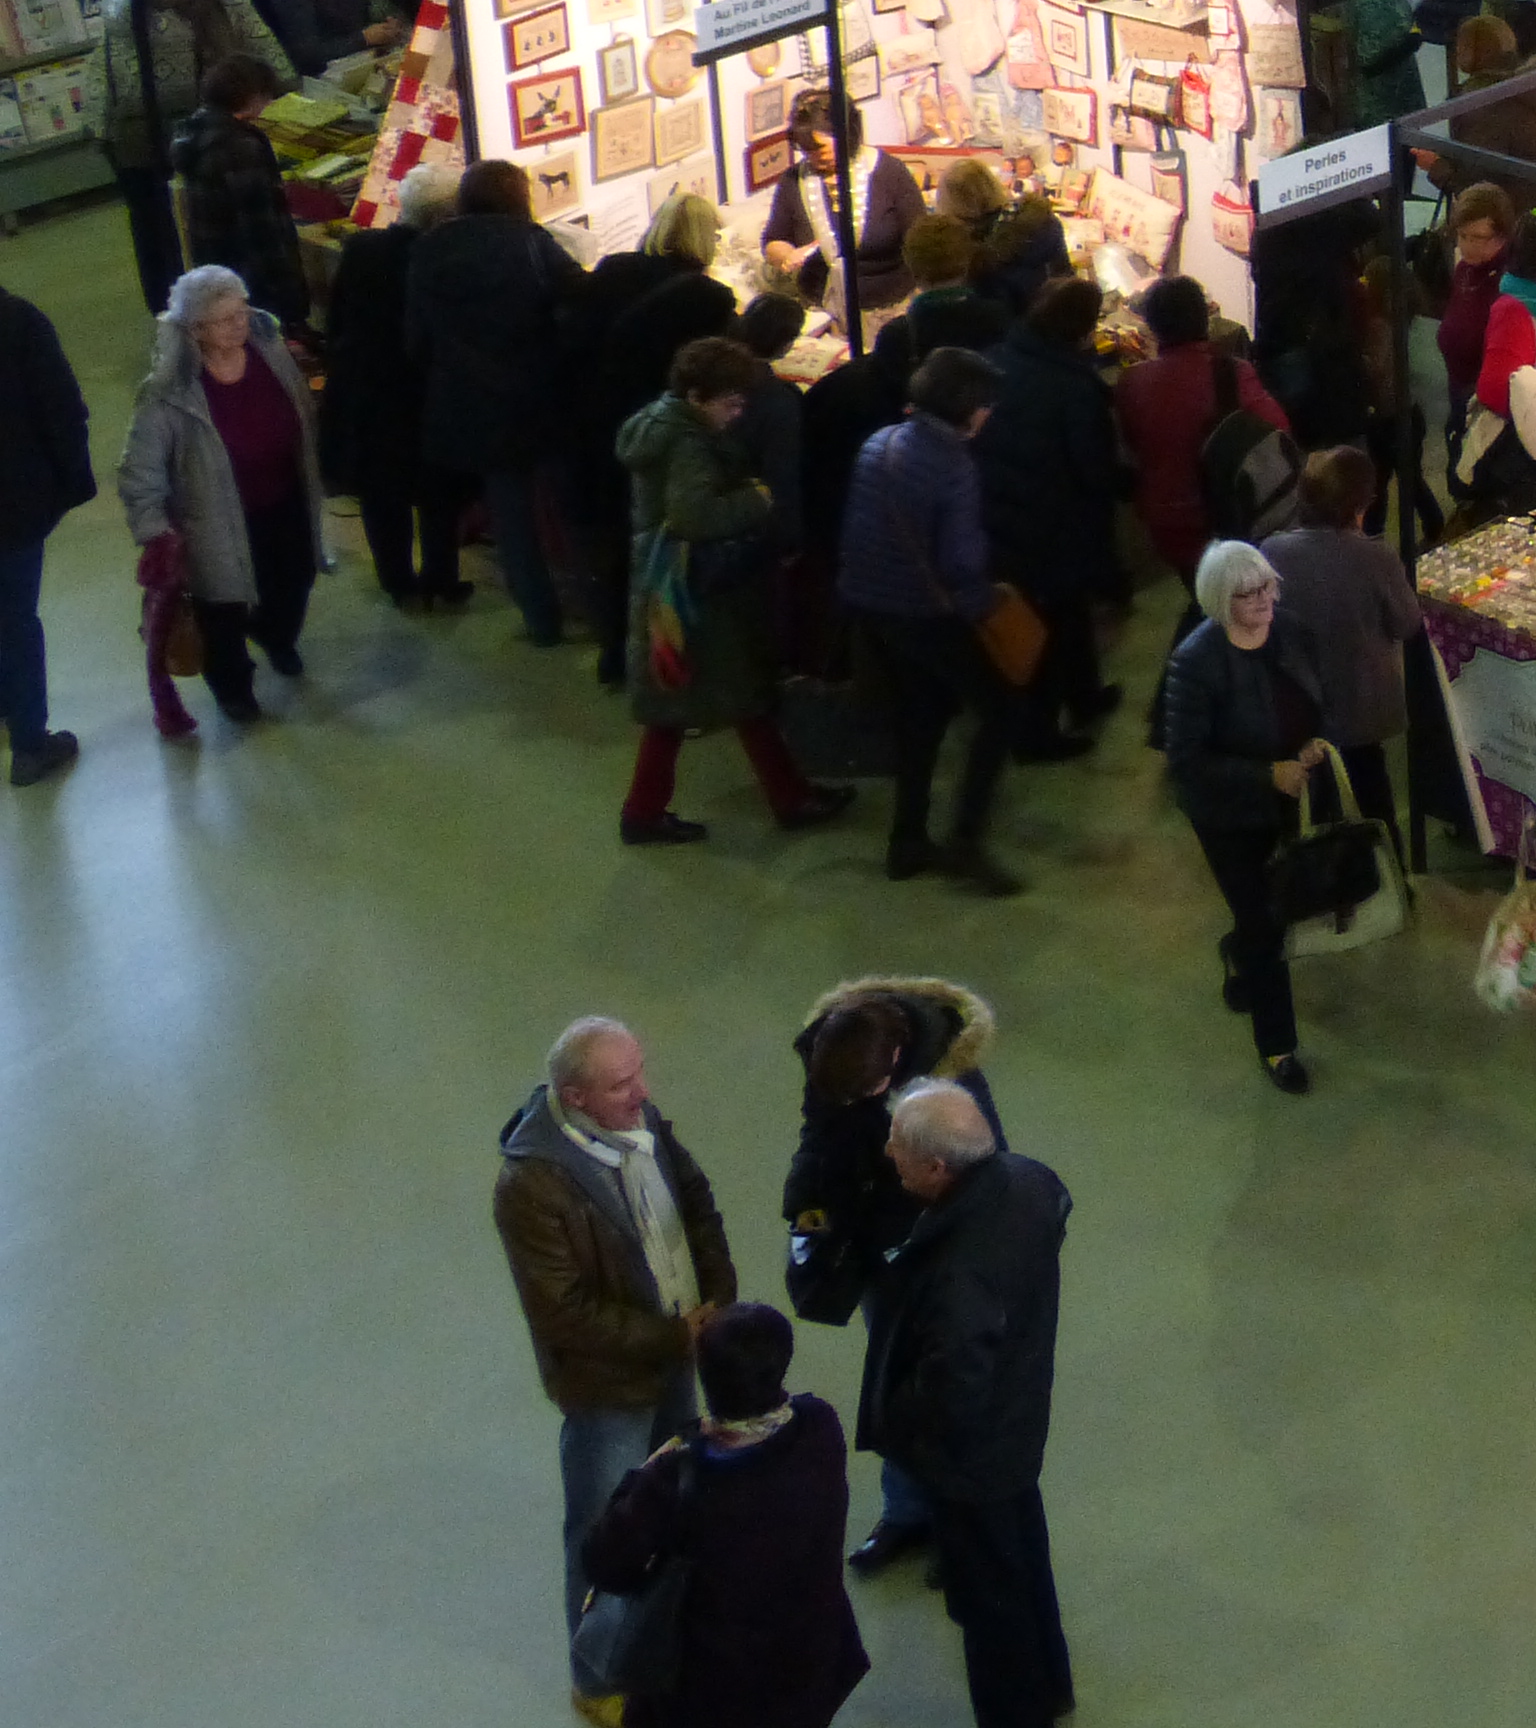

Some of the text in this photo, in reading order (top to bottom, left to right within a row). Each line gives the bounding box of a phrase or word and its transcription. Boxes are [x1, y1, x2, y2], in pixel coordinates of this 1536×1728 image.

[713, 9, 731, 22] Au
[733, 1, 748, 16] Fil
[713, 18, 759, 41] Martine
[1304, 150, 1347, 173] Perles
[1278, 162, 1374, 204] et inspirations
